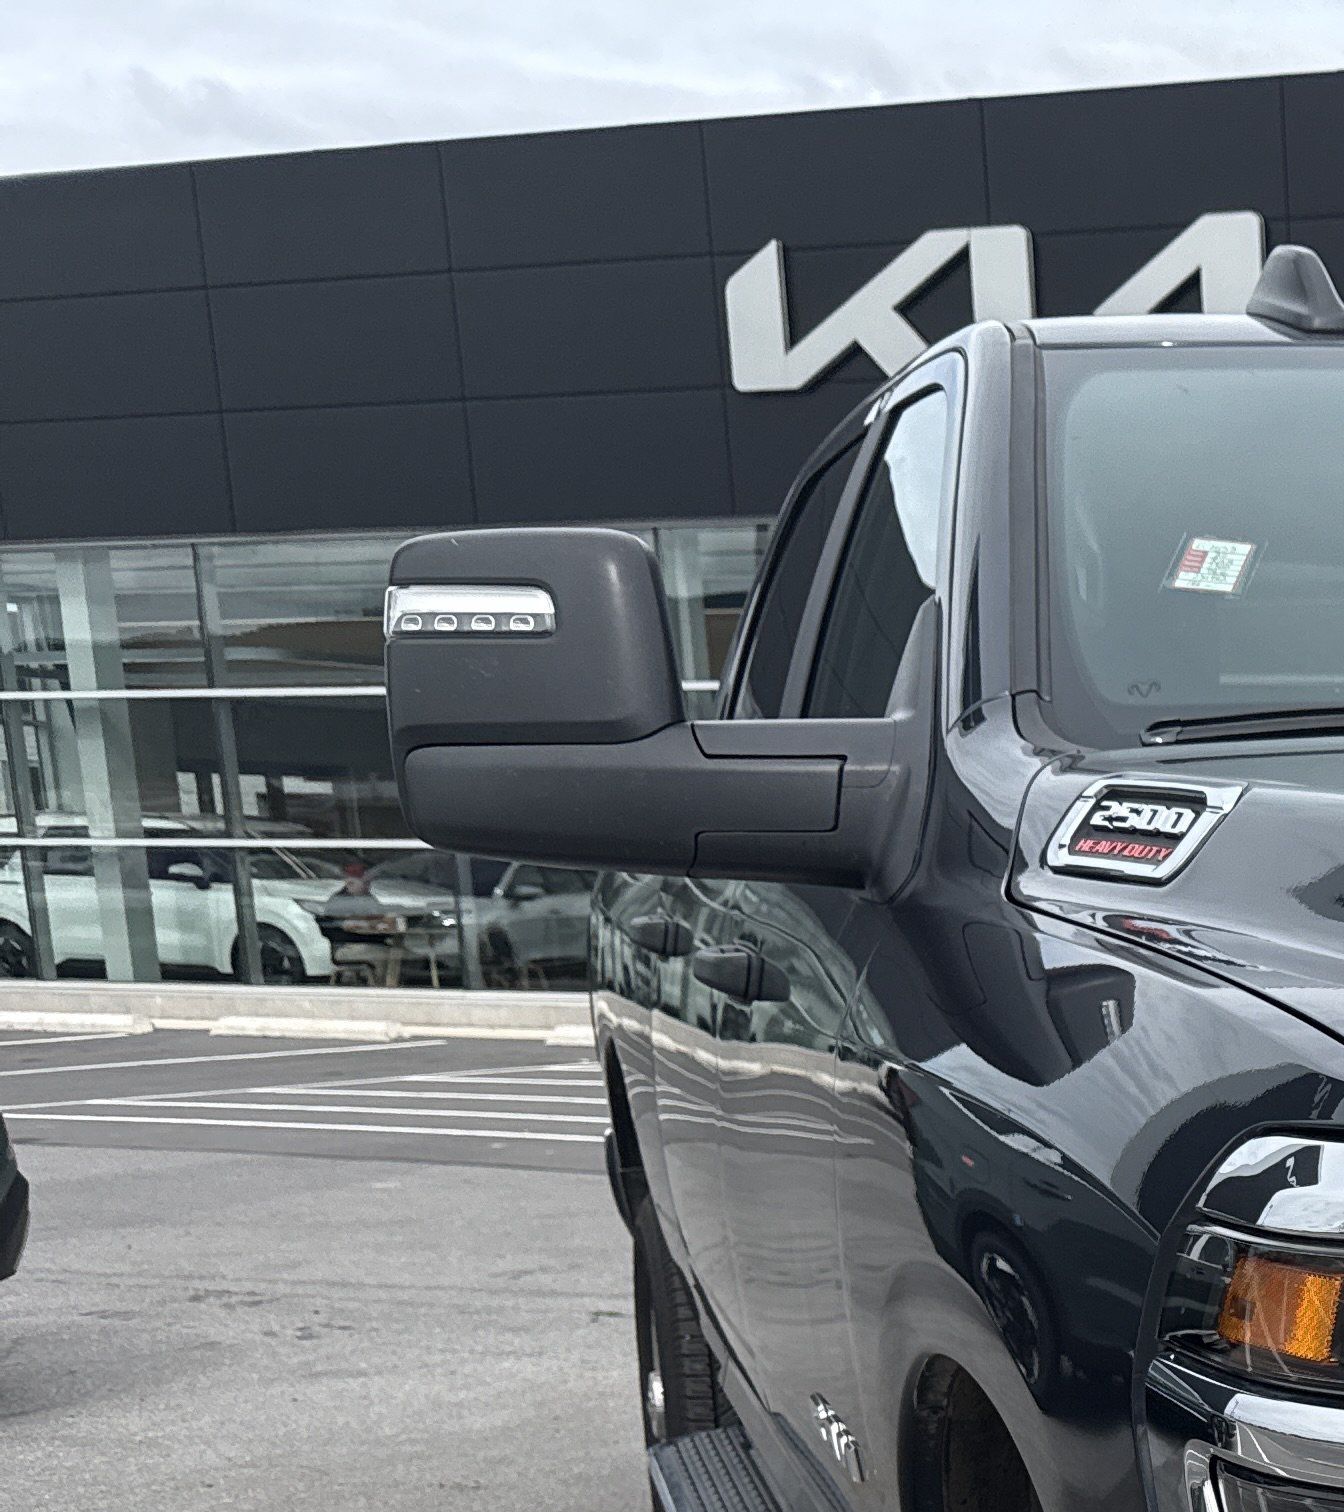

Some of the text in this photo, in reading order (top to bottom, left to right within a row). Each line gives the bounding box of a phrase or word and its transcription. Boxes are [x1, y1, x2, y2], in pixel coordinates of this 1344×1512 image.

[725, 210, 1264, 392] KIA
[1089, 800, 1196, 834] 2500
[1076, 839, 1173, 861] HEAVY DUTY
